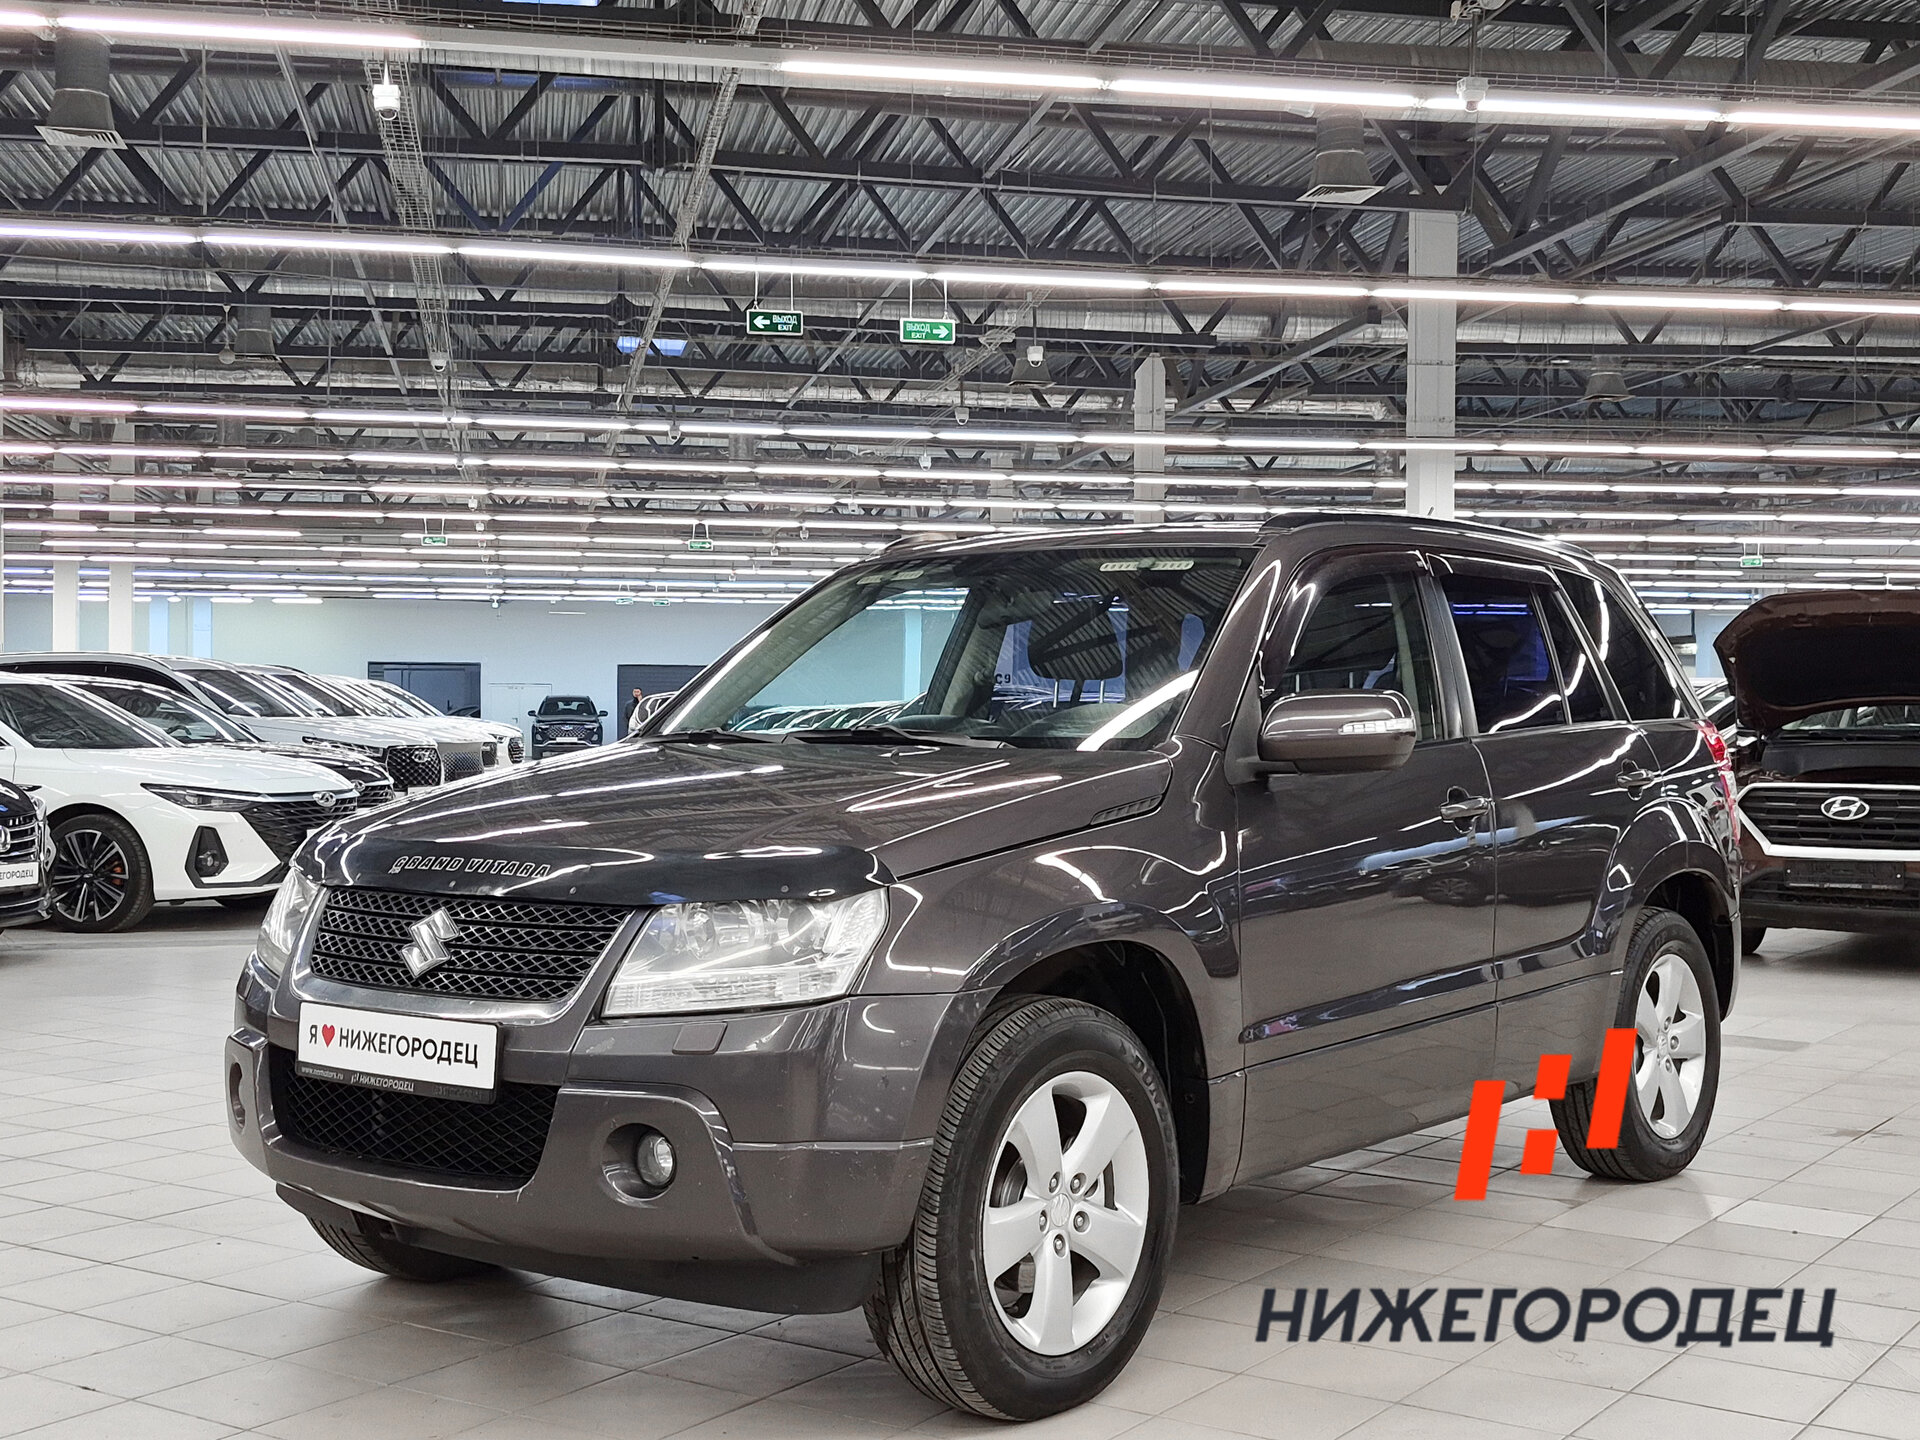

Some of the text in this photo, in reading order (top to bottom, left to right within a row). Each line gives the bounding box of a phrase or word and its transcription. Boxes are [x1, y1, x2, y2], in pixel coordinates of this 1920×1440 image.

[772, 314, 798, 325] ВЫХОД
[906, 322, 931, 334] ВЫХОД
[911, 331, 926, 339] EXIT
[394, 856, 551, 878] GRAND VITARA
[309, 1024, 478, 1069] Я НИЖЕГОРОДЕЦ
[359, 1074, 414, 1092] НИЖЕГОРОДЕЦ
